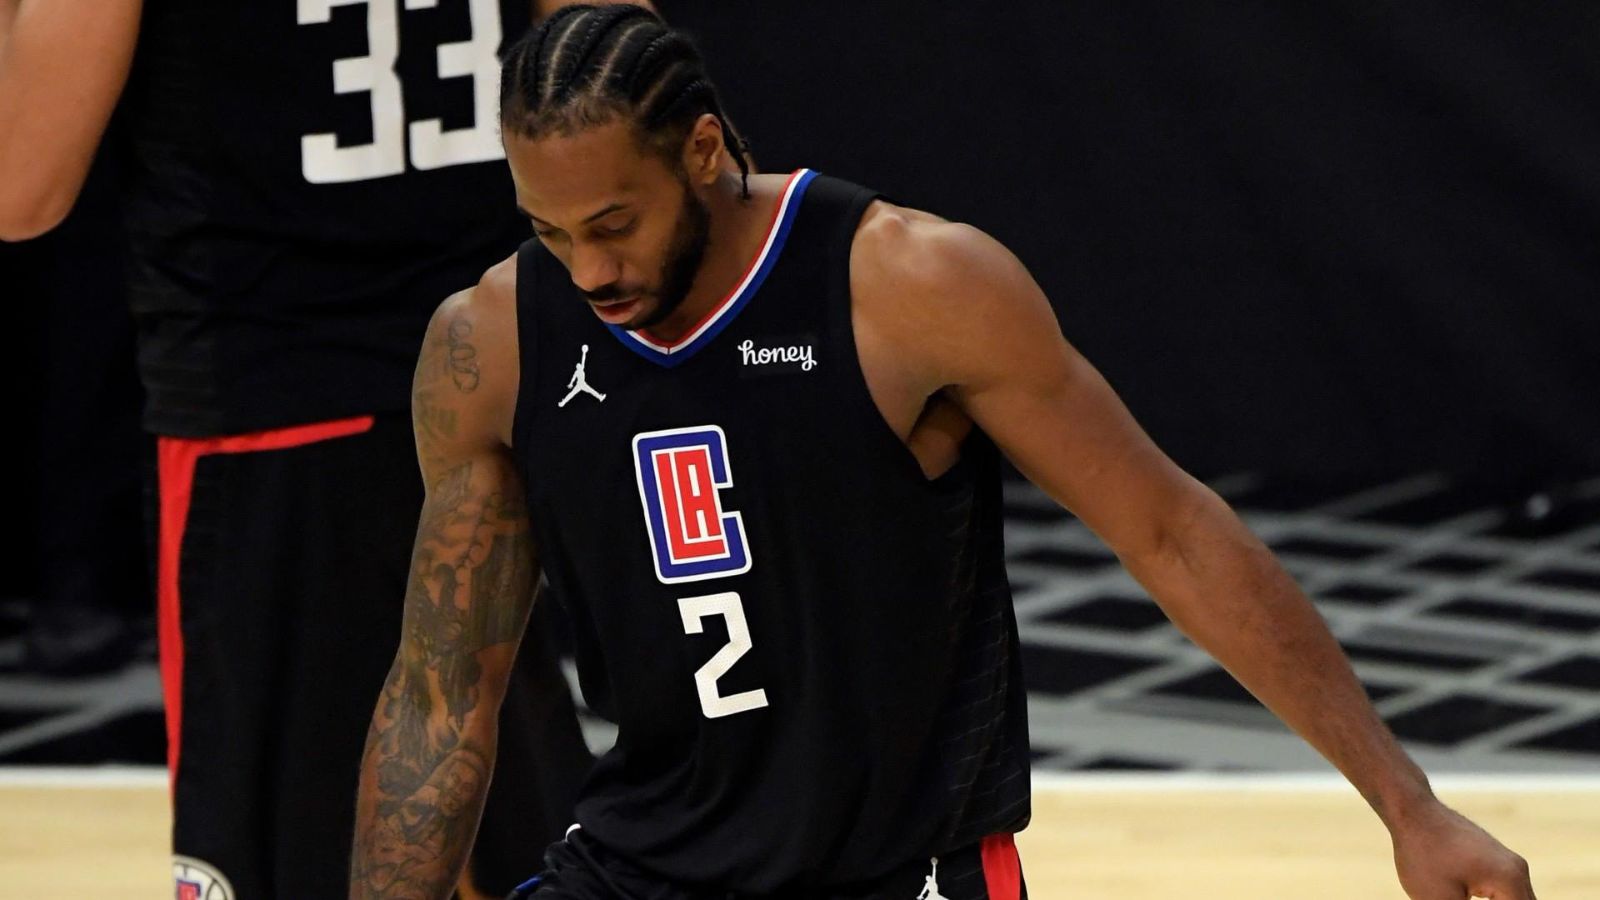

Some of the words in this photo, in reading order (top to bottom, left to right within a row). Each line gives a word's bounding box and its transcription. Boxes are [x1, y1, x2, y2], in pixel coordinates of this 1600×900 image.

[297, 0, 507, 184] 33
[737, 339, 818, 371] honey
[677, 591, 769, 718] 2
